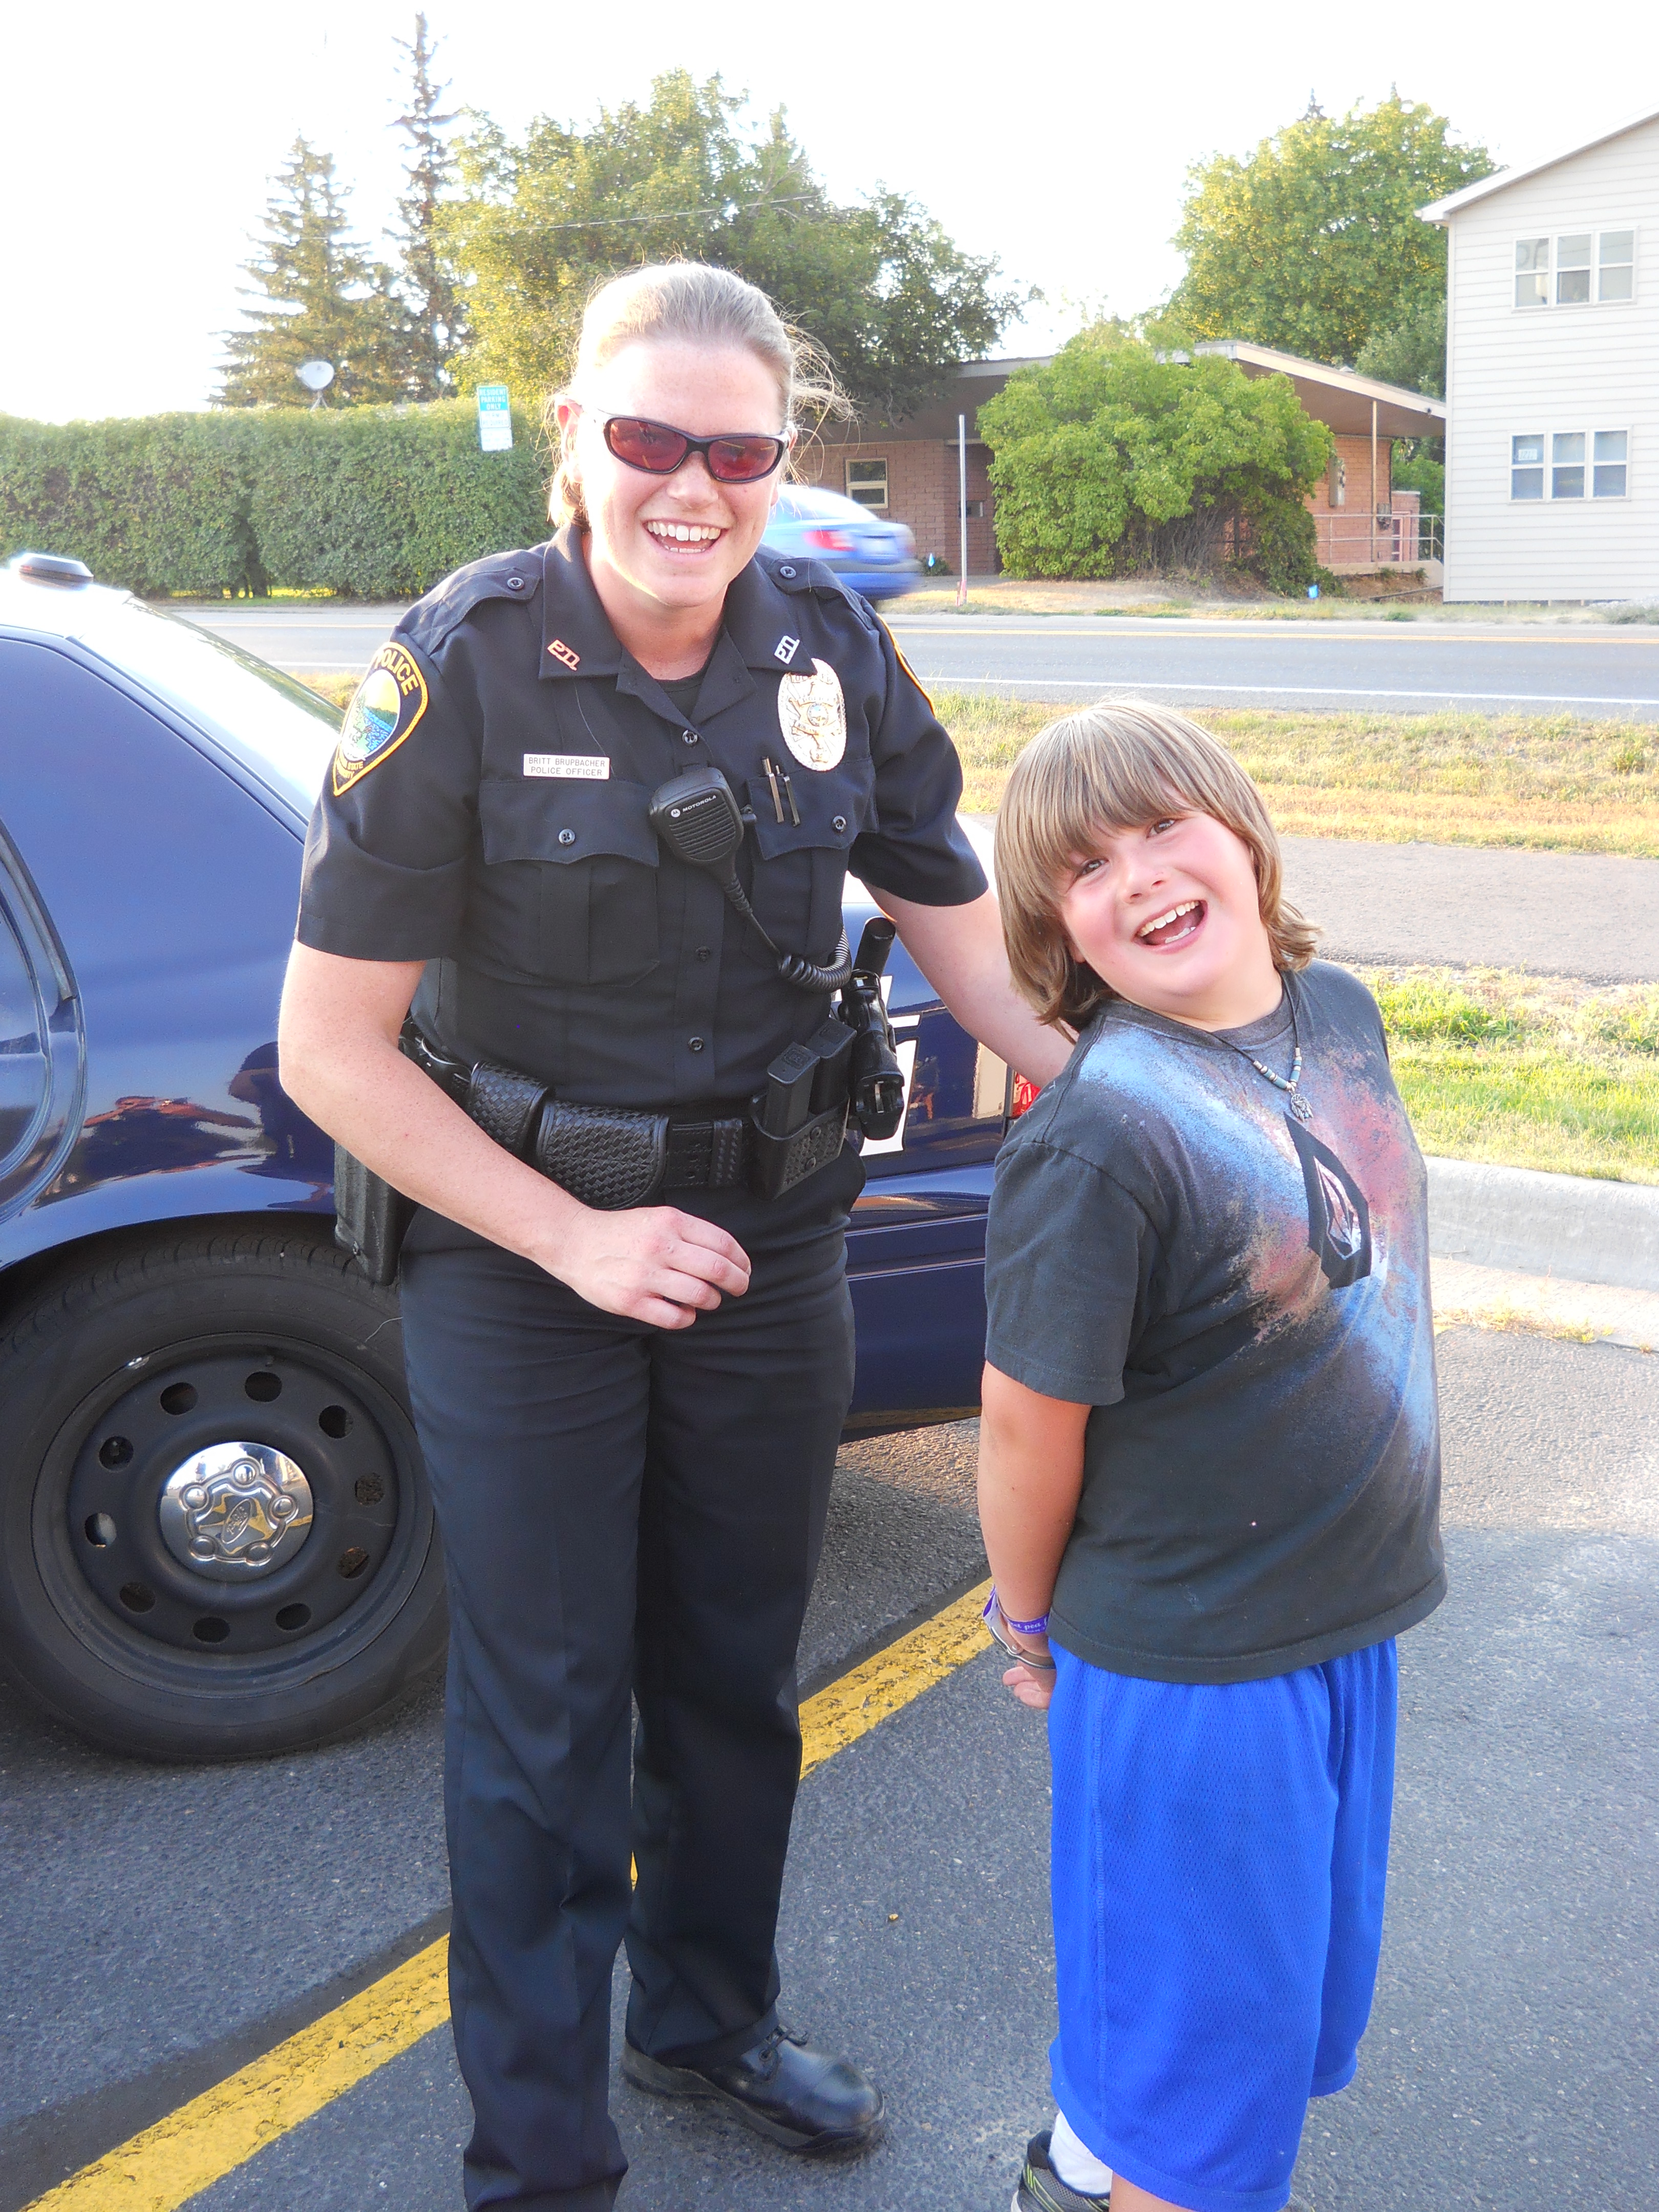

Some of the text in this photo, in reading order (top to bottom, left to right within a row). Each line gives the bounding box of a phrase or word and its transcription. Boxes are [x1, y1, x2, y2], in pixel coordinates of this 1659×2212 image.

[374, 649, 418, 696] POLICE
[347, 761, 364, 770] STATE
[555, 758, 605, 767] BRUPBACHER
[531, 767, 602, 776] POLICE OFFICER
[683, 795, 716, 812] MOTOROLA
[1025, 1623, 1041, 1631] pea
